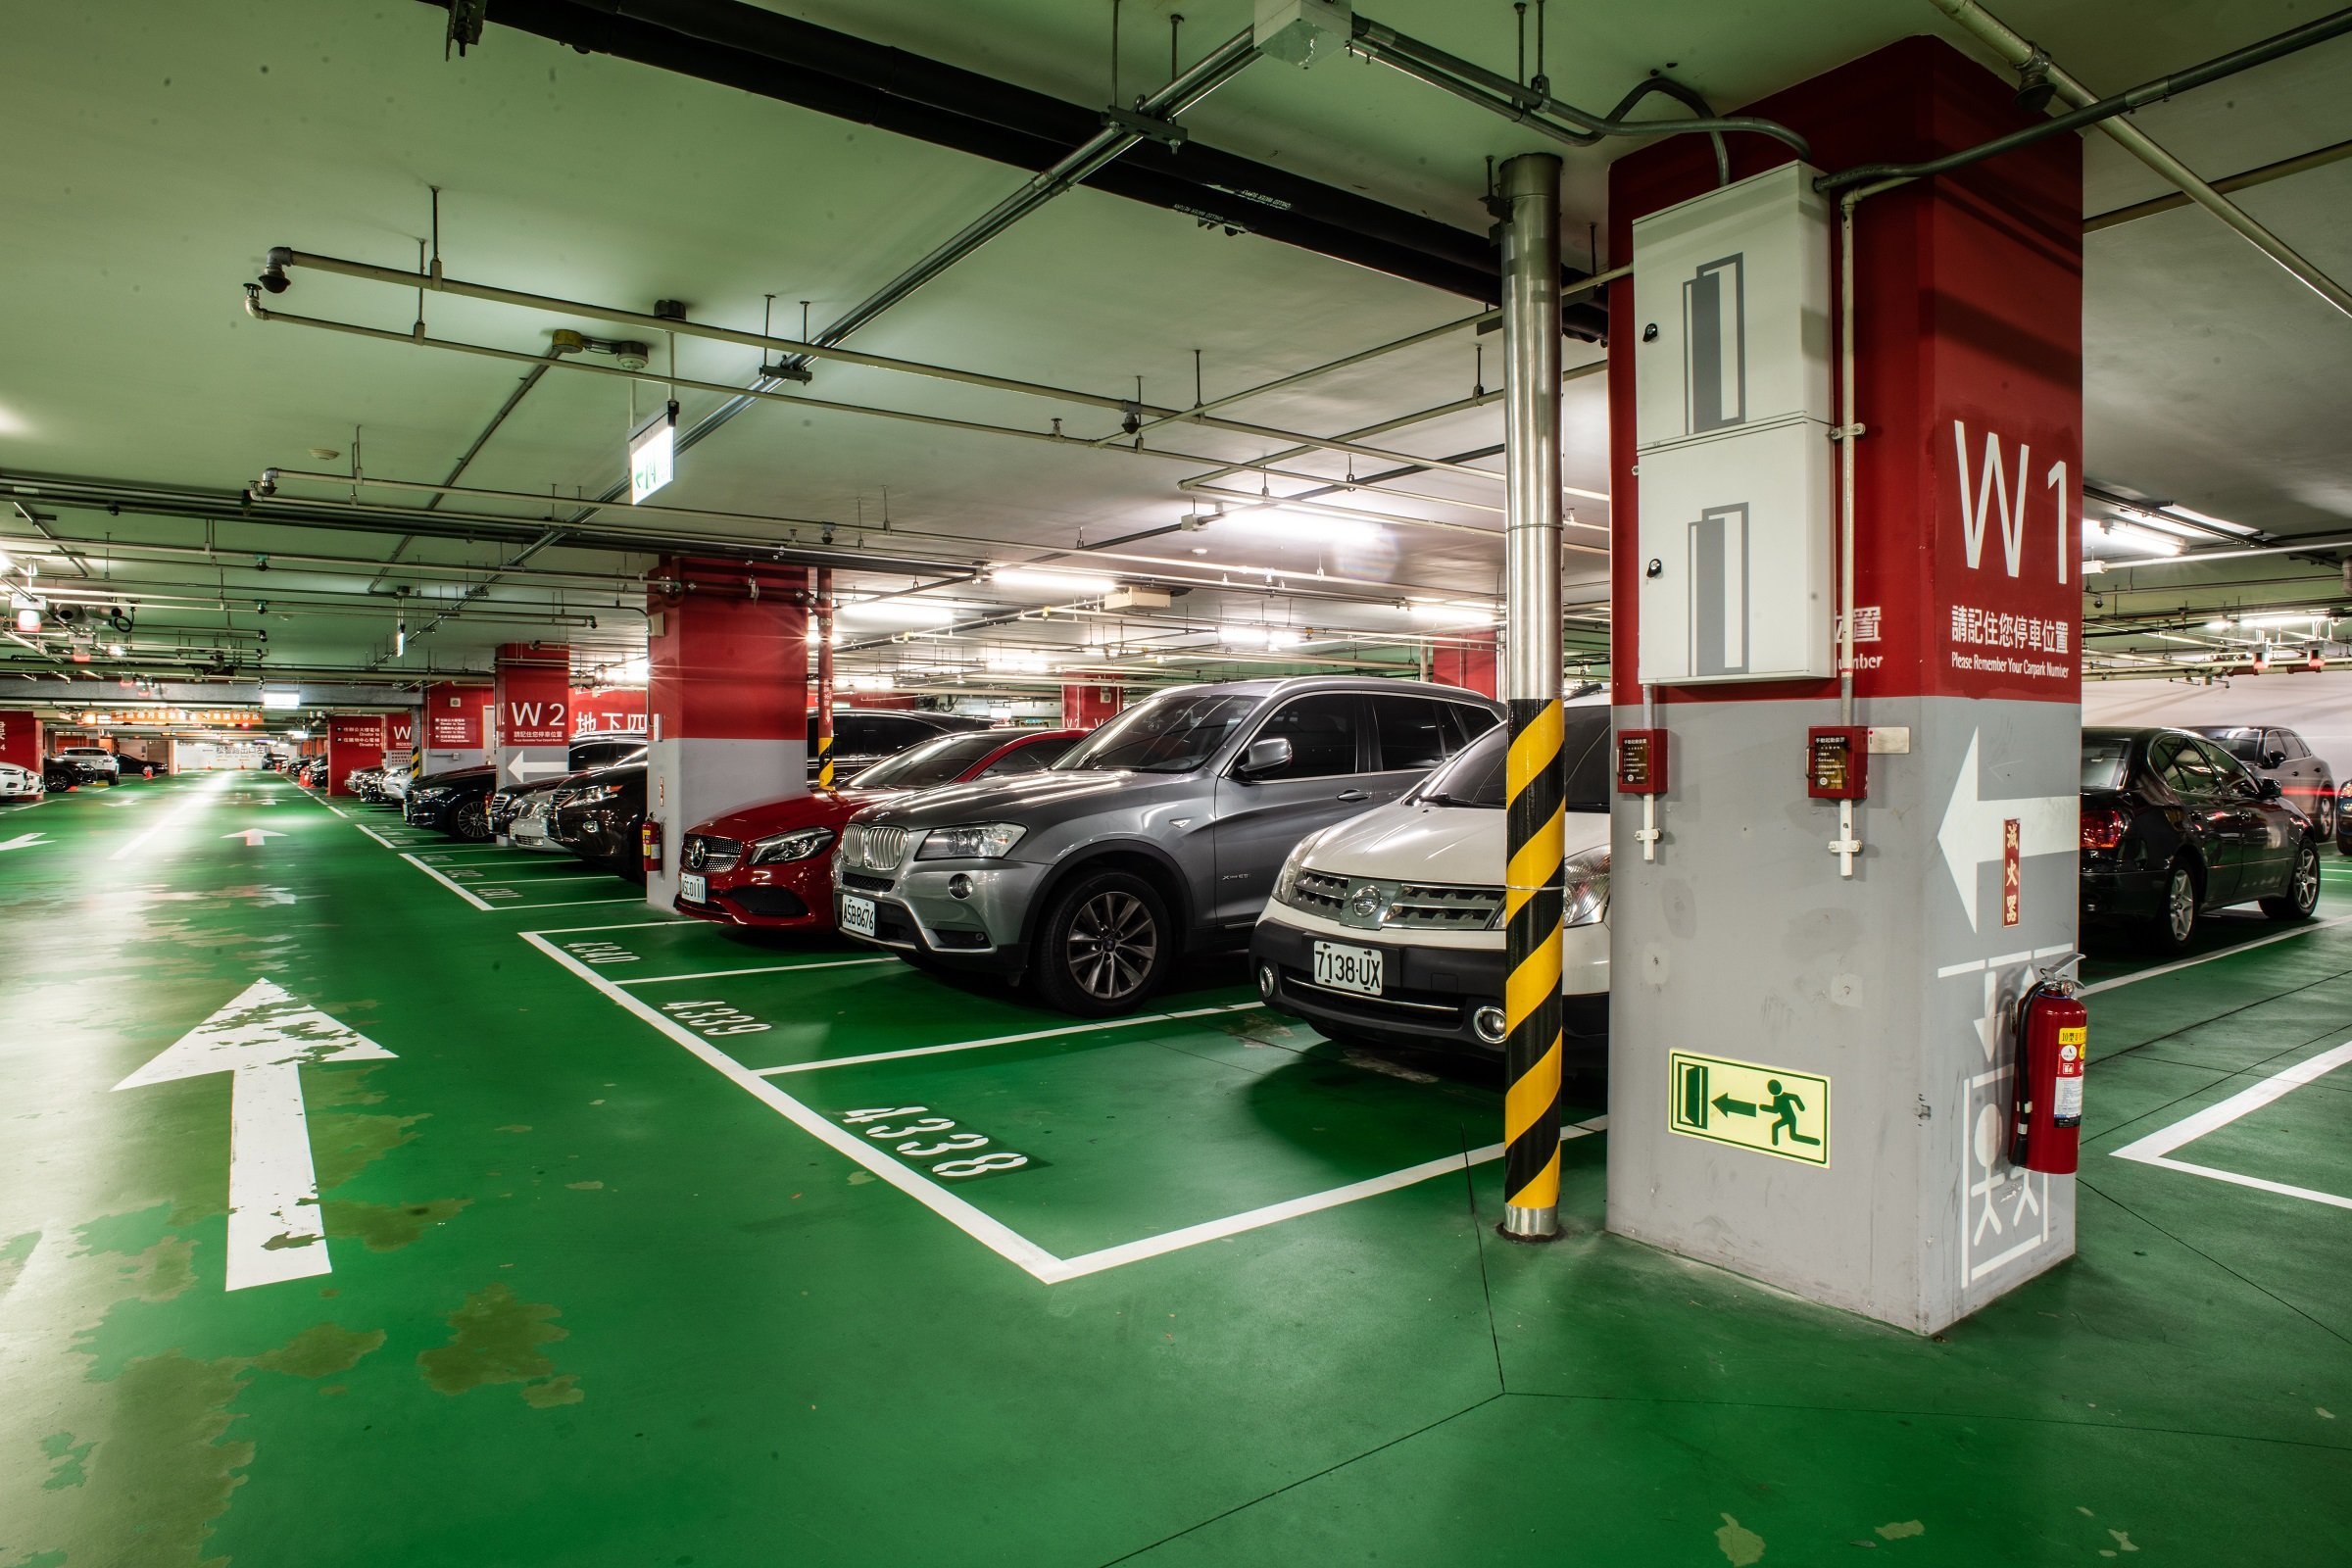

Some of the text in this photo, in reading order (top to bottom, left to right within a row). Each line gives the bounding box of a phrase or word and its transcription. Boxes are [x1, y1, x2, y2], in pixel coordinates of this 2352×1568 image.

[1954, 419, 2030, 578] W
[1951, 605, 2069, 655] 請記住您停車位置
[1951, 651, 2070, 679] Please Remember Your Carpark Number
[512, 702, 542, 726] W
[575, 711, 647, 732] 地下四
[2006, 823, 2019, 923] 滅火器
[563, 942, 641, 963] 4340
[1315, 951, 1381, 989] 7138-UX
[662, 1001, 772, 1036] 4339
[842, 1105, 1028, 1177] 4338
